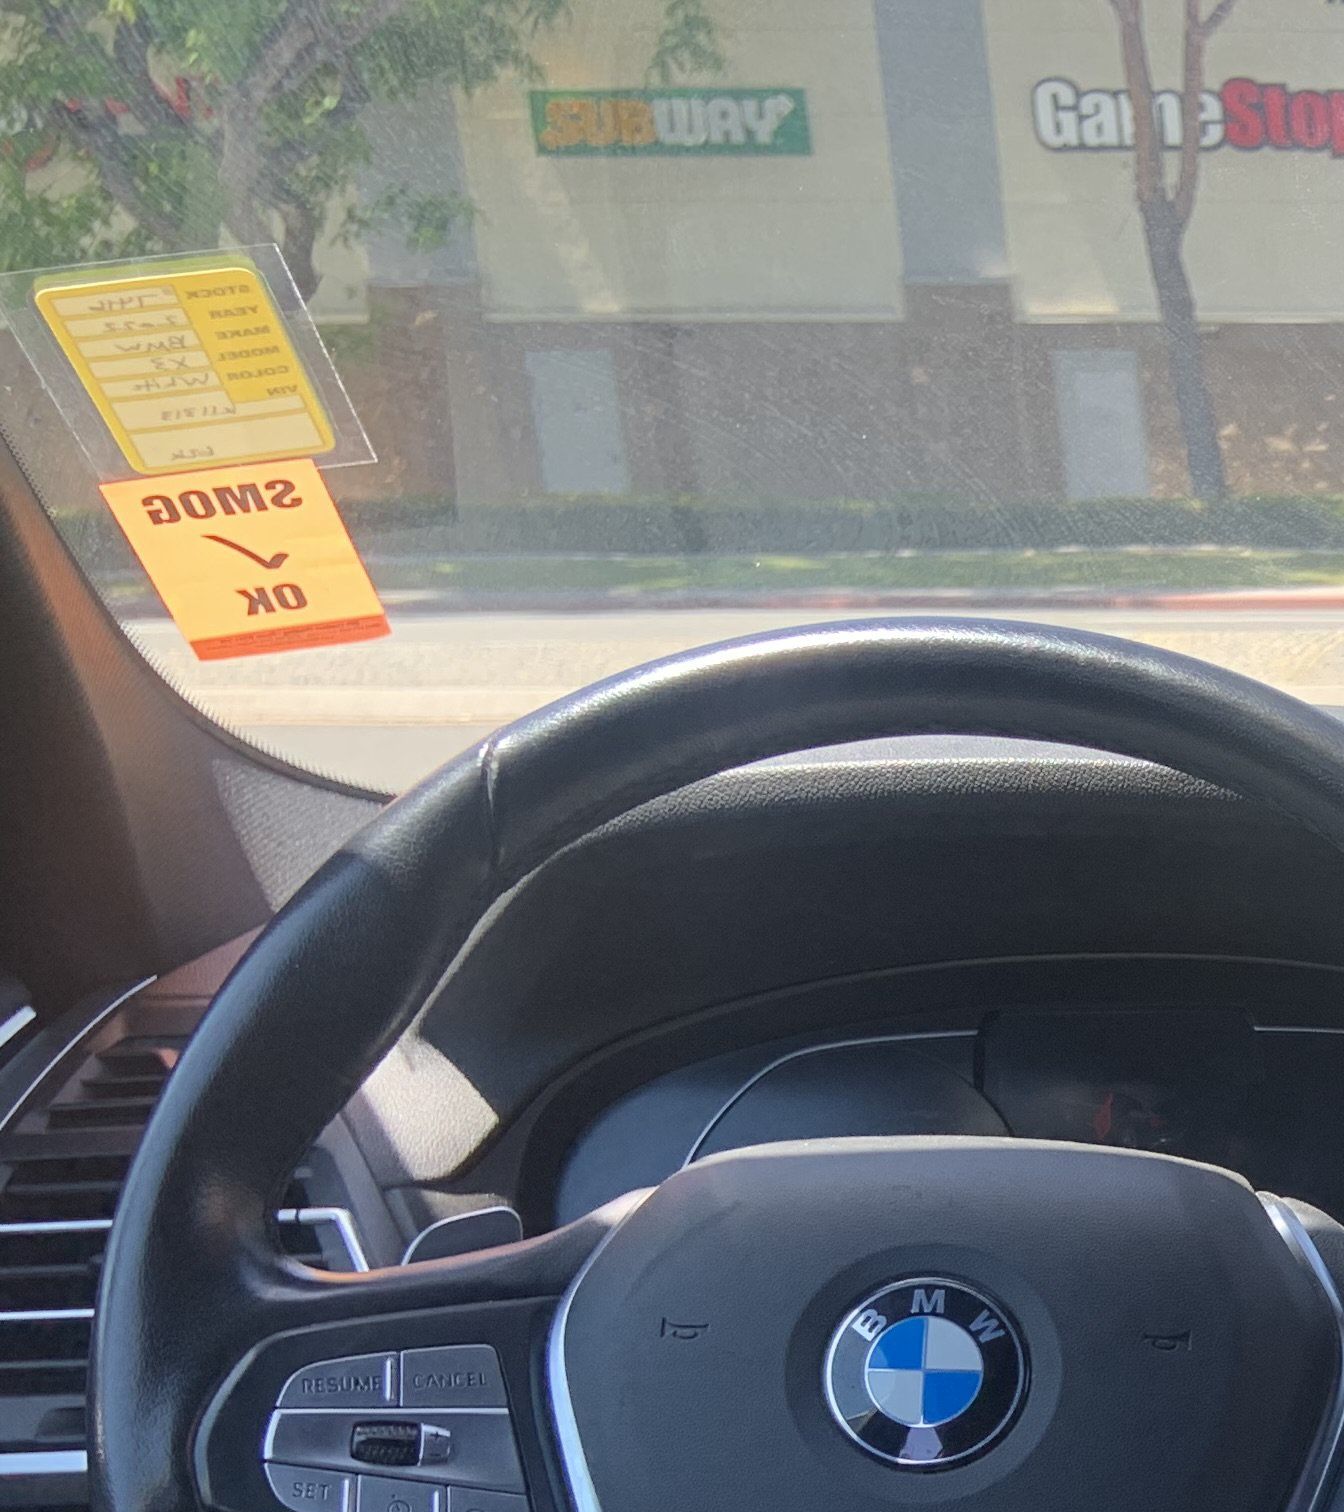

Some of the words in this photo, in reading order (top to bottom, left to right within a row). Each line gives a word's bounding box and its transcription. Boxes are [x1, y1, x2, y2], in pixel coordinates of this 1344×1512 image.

[539, 93, 794, 150] SUBWAY
[852, 1288, 1006, 1344] BMW
[302, 1375, 383, 1394] RESUME
[412, 1372, 488, 1390] CANCEL
[292, 1482, 332, 1500] SET
